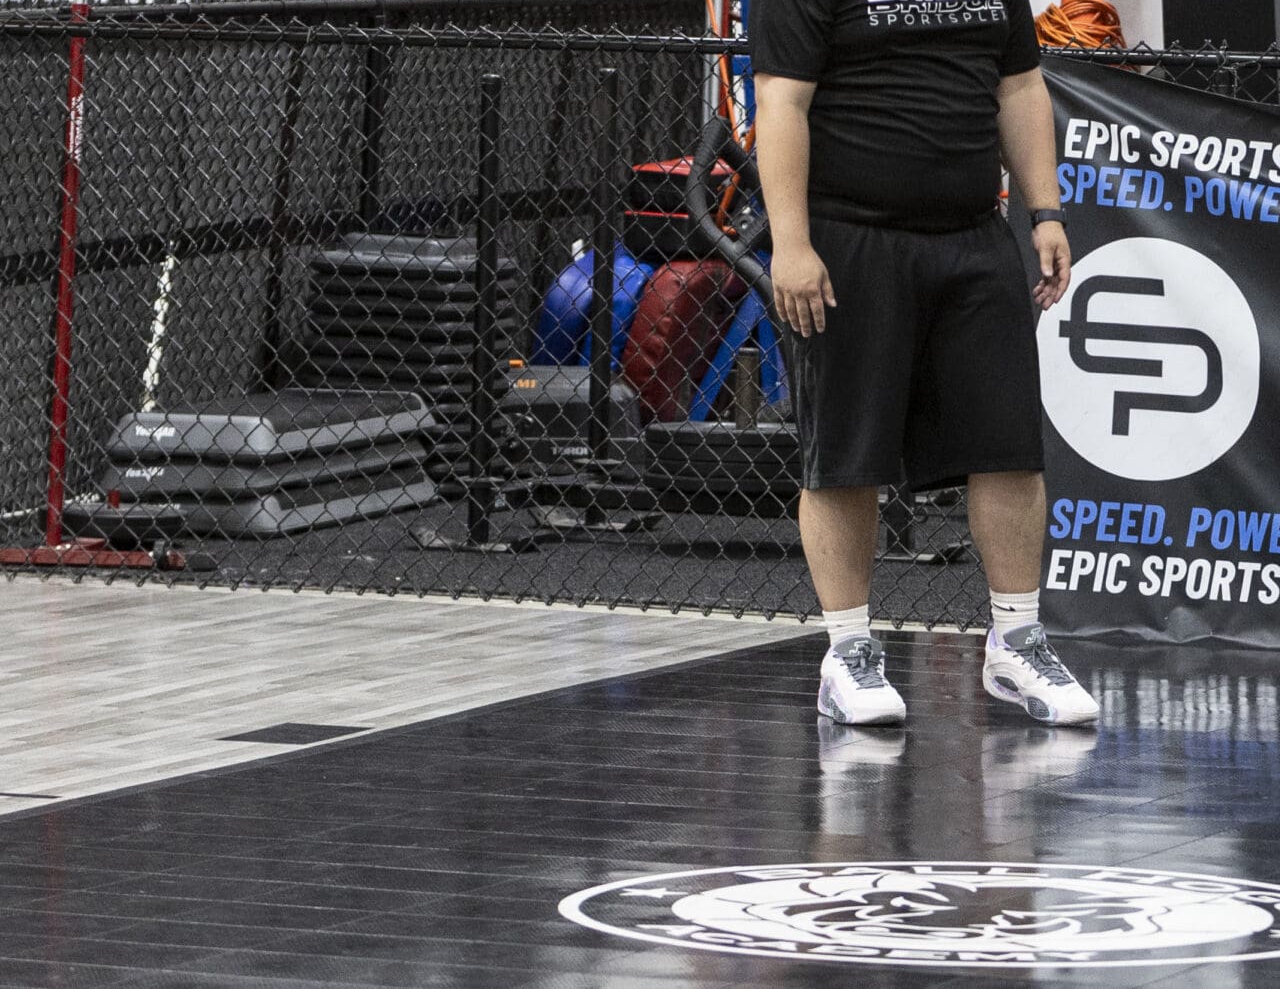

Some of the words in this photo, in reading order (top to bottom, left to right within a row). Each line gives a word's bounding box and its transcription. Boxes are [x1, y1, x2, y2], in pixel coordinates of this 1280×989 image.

[1064, 118, 1140, 163] EPIC
[1057, 163, 1173, 211] SPEED.
[1049, 498, 1173, 546] SPEED.
[1046, 549, 1130, 594] EPIC
